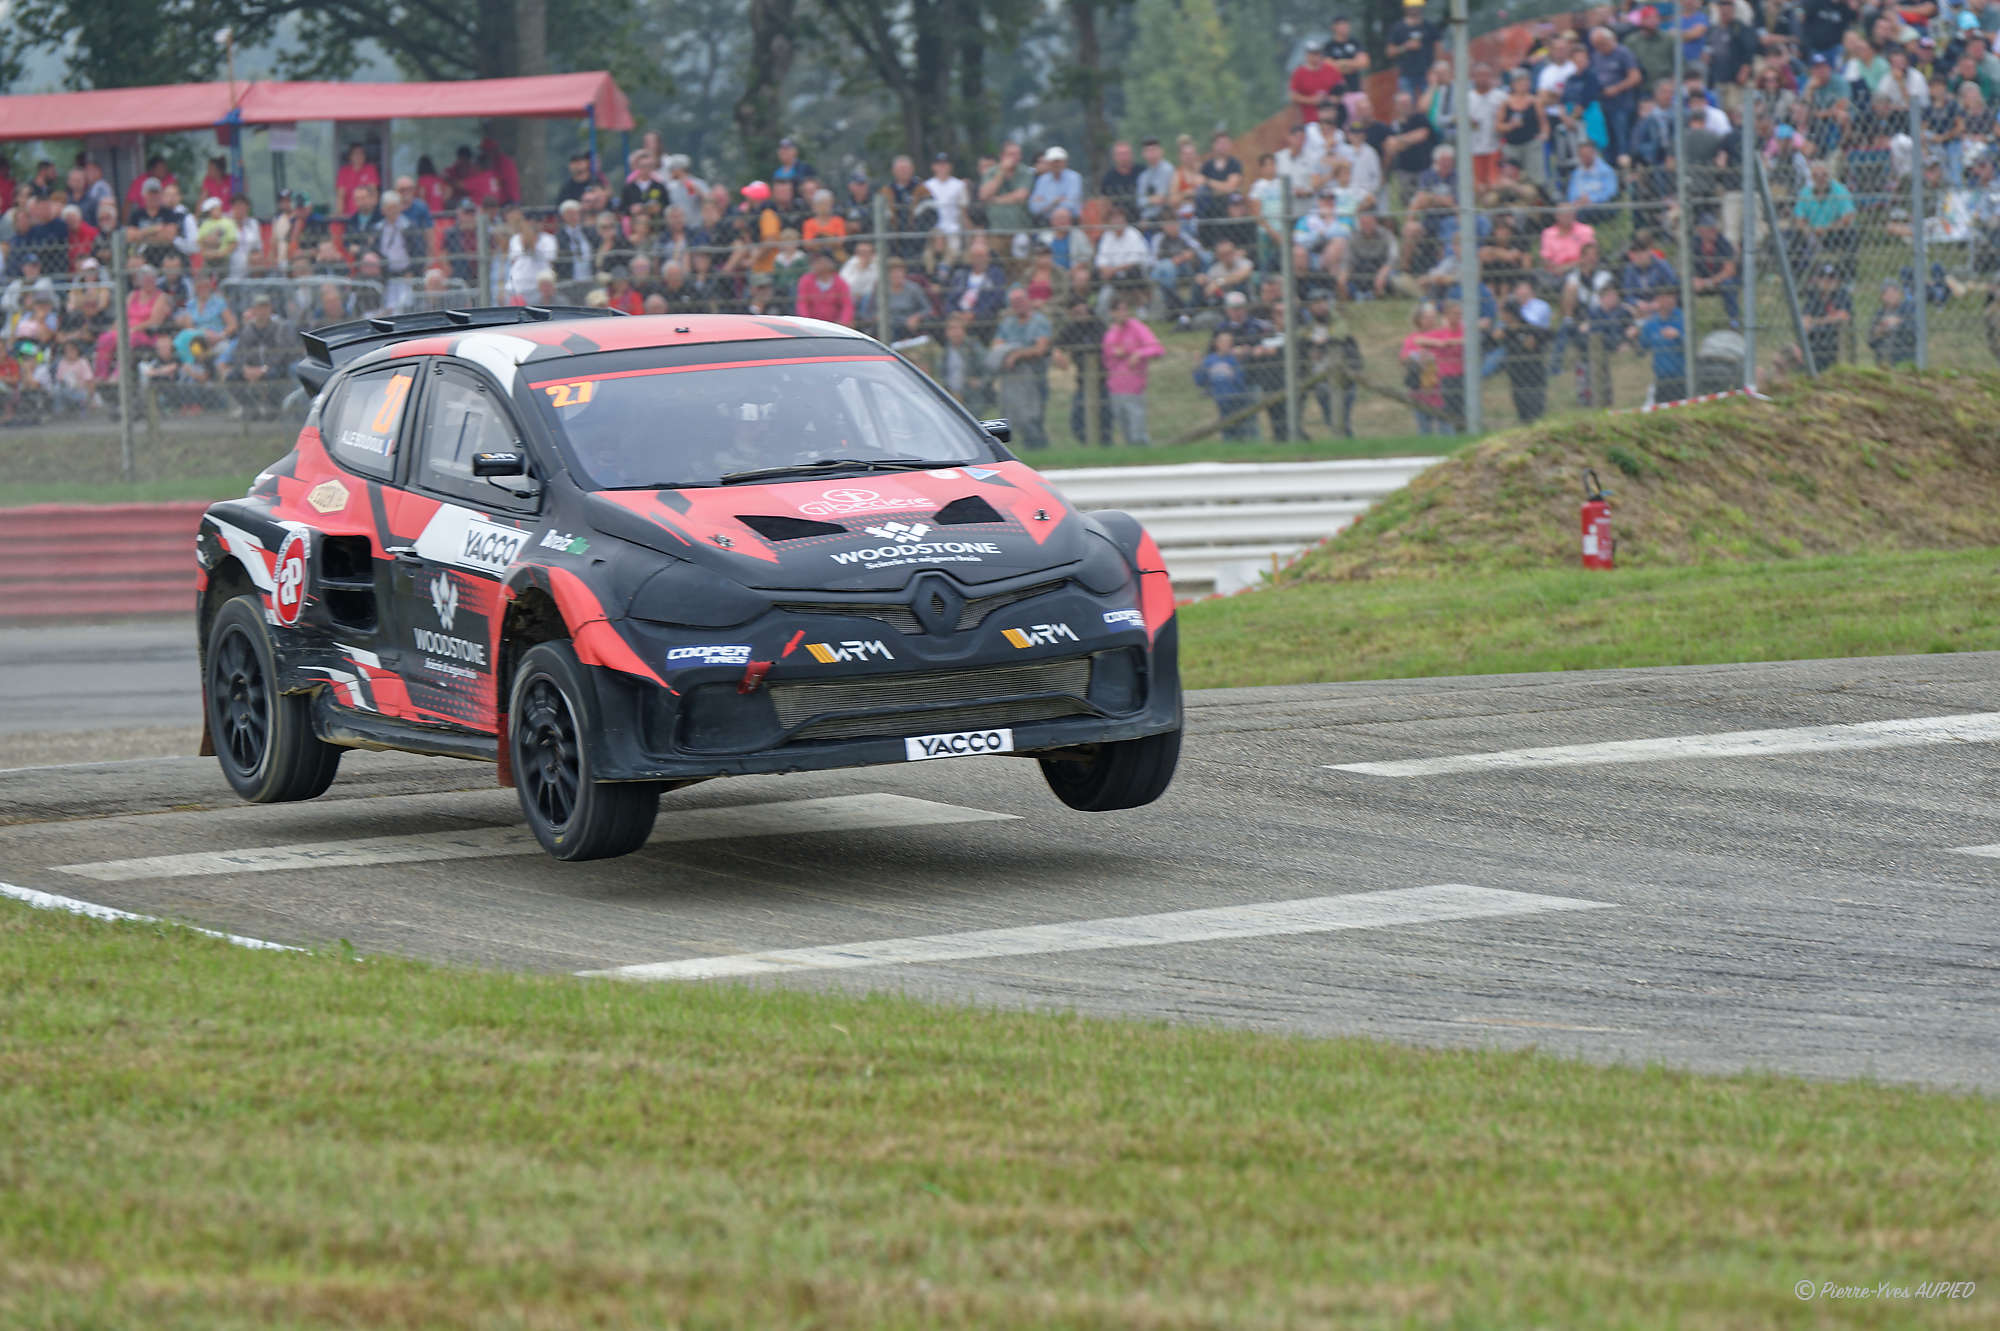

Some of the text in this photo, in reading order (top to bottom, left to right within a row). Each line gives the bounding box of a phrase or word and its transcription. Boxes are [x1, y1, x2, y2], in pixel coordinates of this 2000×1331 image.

[545, 381, 592, 408] 27
[464, 530, 518, 566] YACCO
[830, 542, 1002, 565] WOODSTONE
[1015, 623, 1080, 646] WRM
[413, 628, 487, 666] WOODSTONE
[666, 646, 752, 659] COOPER
[821, 640, 895, 662] WRM
[703, 656, 748, 664] TIRES
[918, 732, 1001, 756] YACCO
